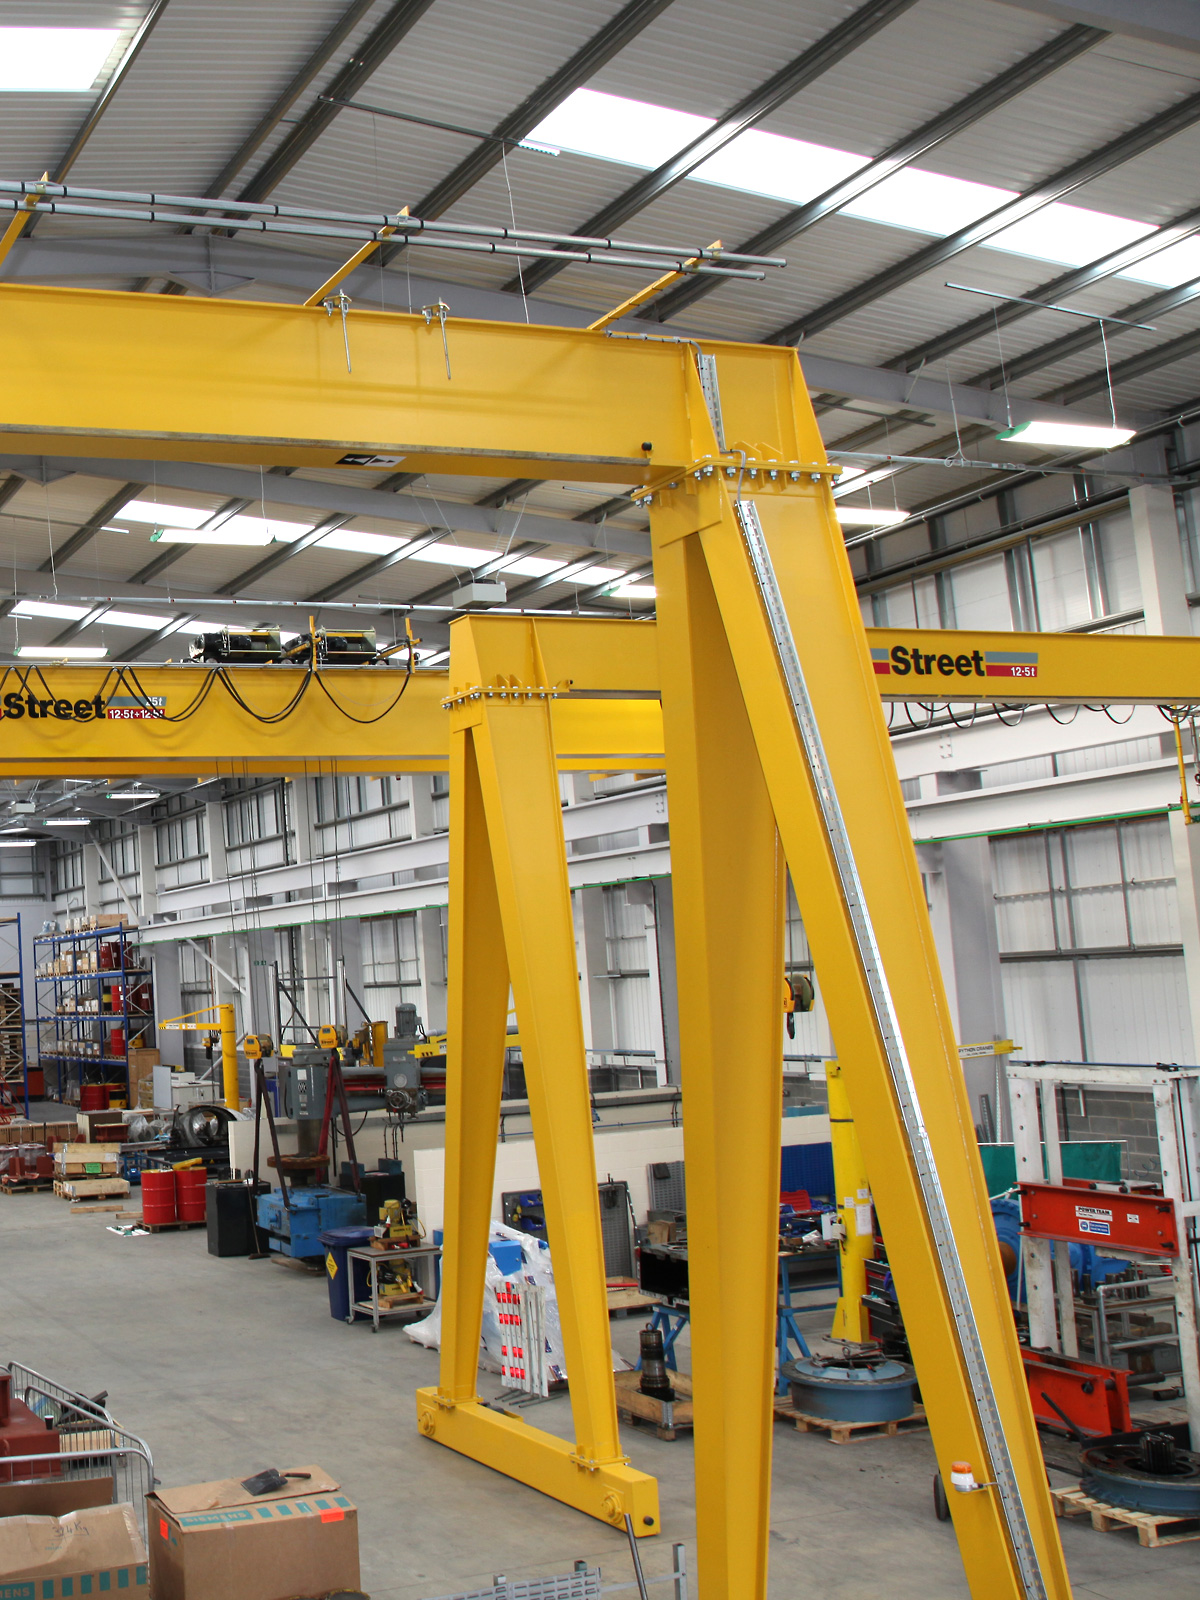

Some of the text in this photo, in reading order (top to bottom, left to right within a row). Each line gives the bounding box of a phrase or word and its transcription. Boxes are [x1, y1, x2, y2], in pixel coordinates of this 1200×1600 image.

[890, 645, 985, 677] Street
[3, 692, 106, 720] Street
[184, 1512, 248, 1524] SIEMENS
